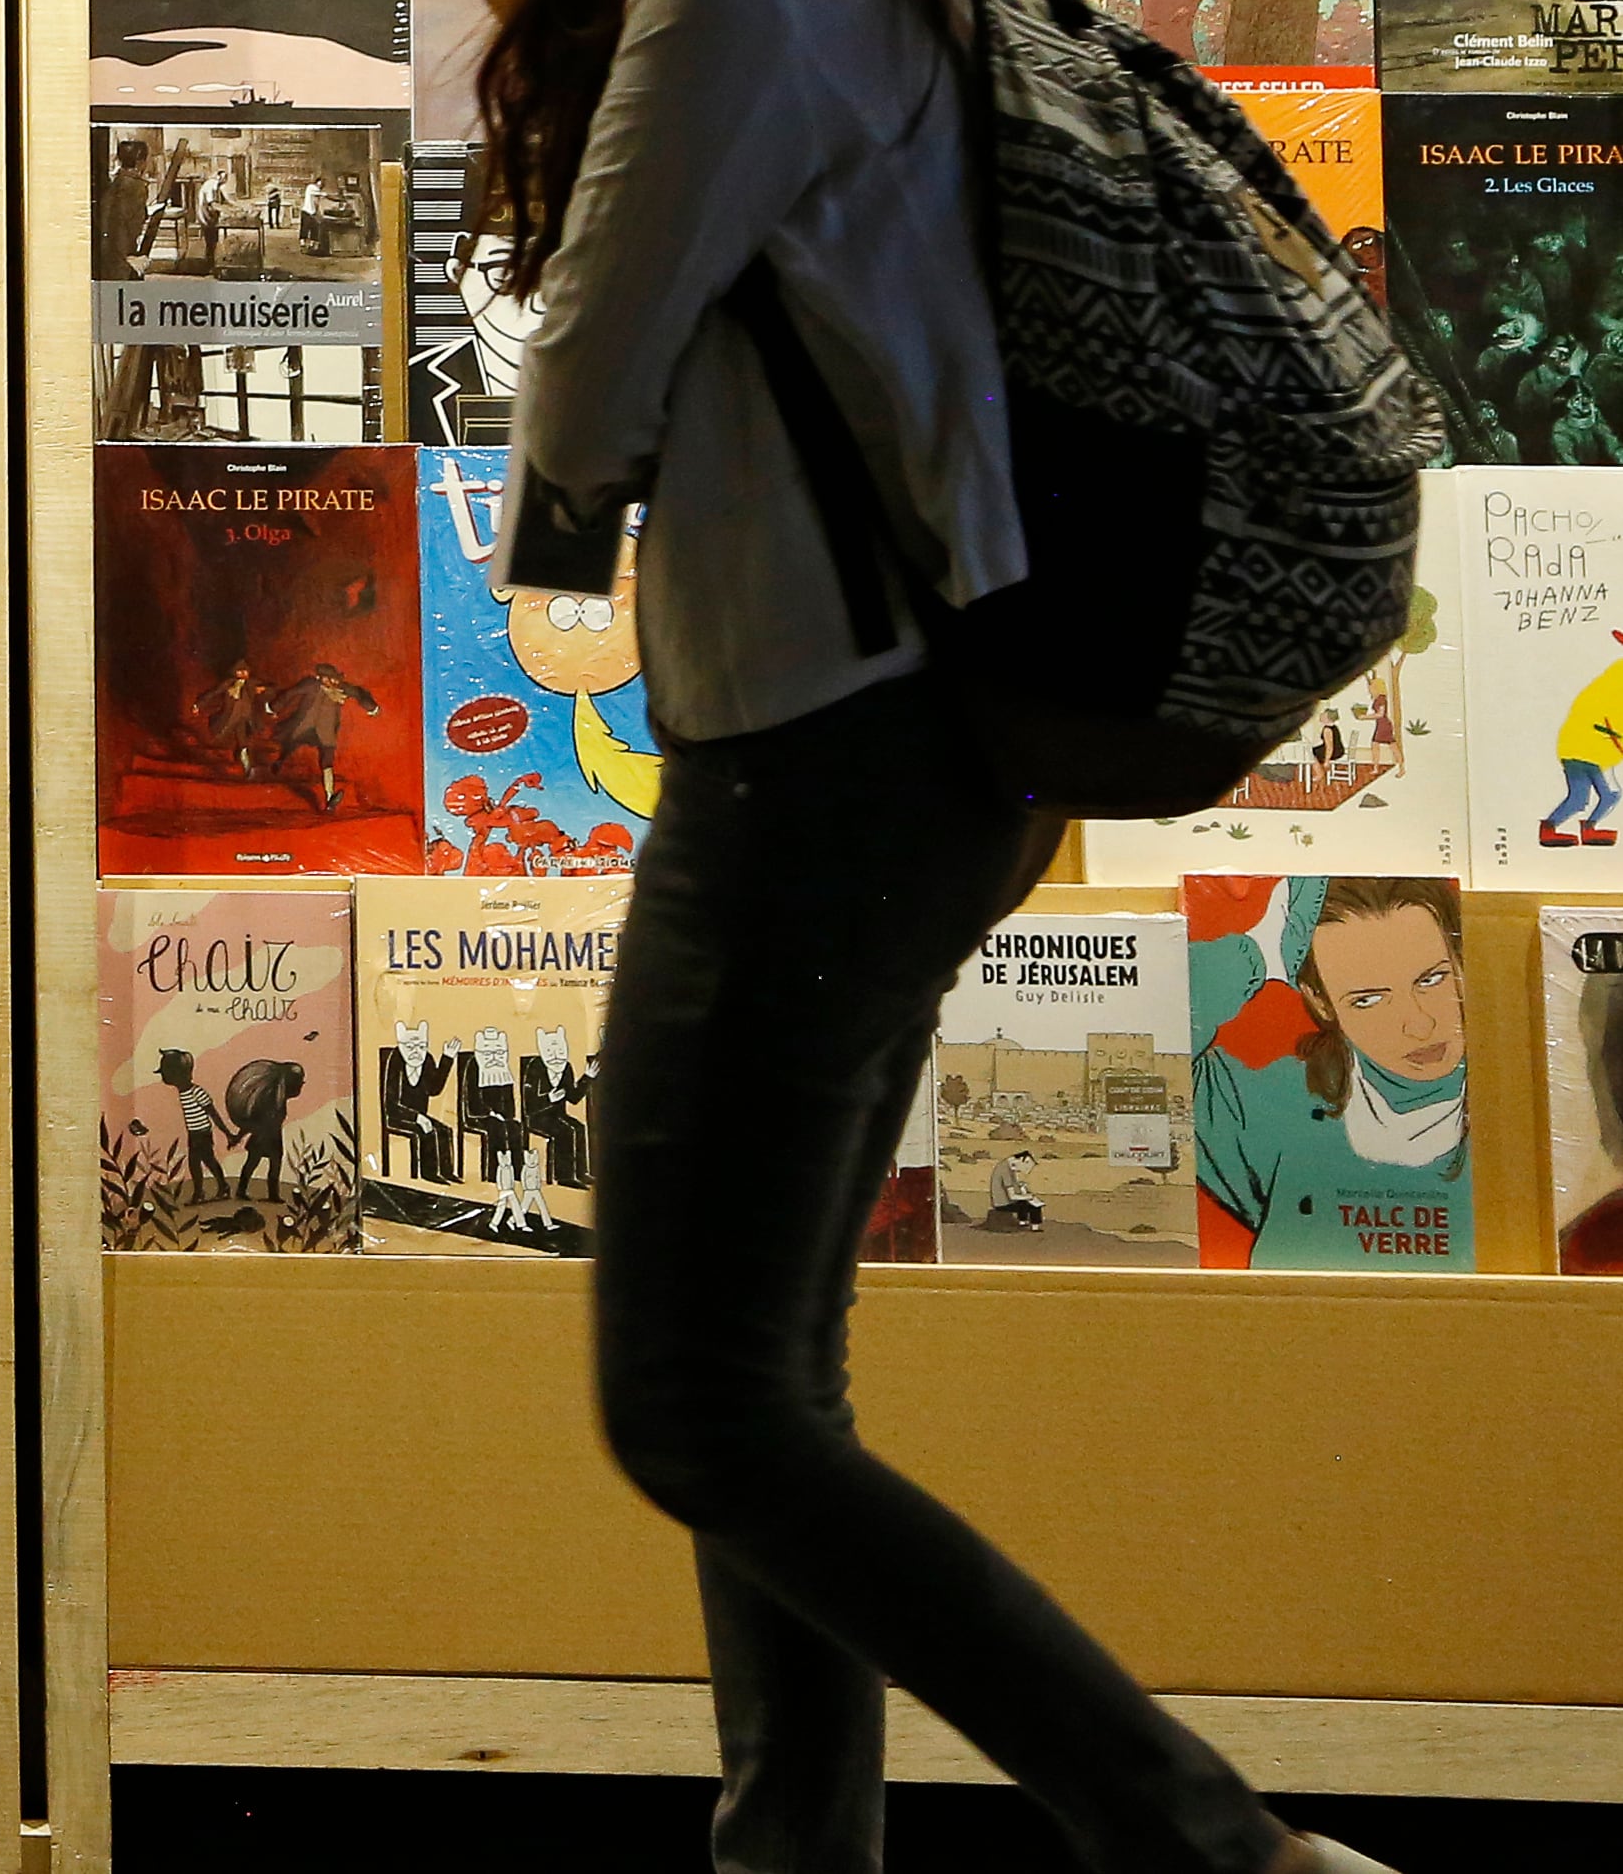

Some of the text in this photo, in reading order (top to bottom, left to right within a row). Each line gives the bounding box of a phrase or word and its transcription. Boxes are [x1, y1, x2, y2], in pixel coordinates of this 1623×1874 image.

[1454, 33, 1553, 48] Clément Belin
[1420, 144, 1549, 164] ISAAC LE
[1504, 177, 1594, 194] Les Glaces
[118, 289, 329, 327] la menuiserie
[326, 292, 364, 308] Aurel
[141, 489, 375, 511] ISAAC LE PIRATE
[245, 524, 291, 544] Olga
[387, 931, 443, 970] LES
[982, 962, 1138, 987] DE JÉRUSALEM
[1015, 989, 1104, 1005] Guy Delisle
[1339, 1205, 1449, 1229] TALC DE
[1359, 1232, 1449, 1255] VERRE
